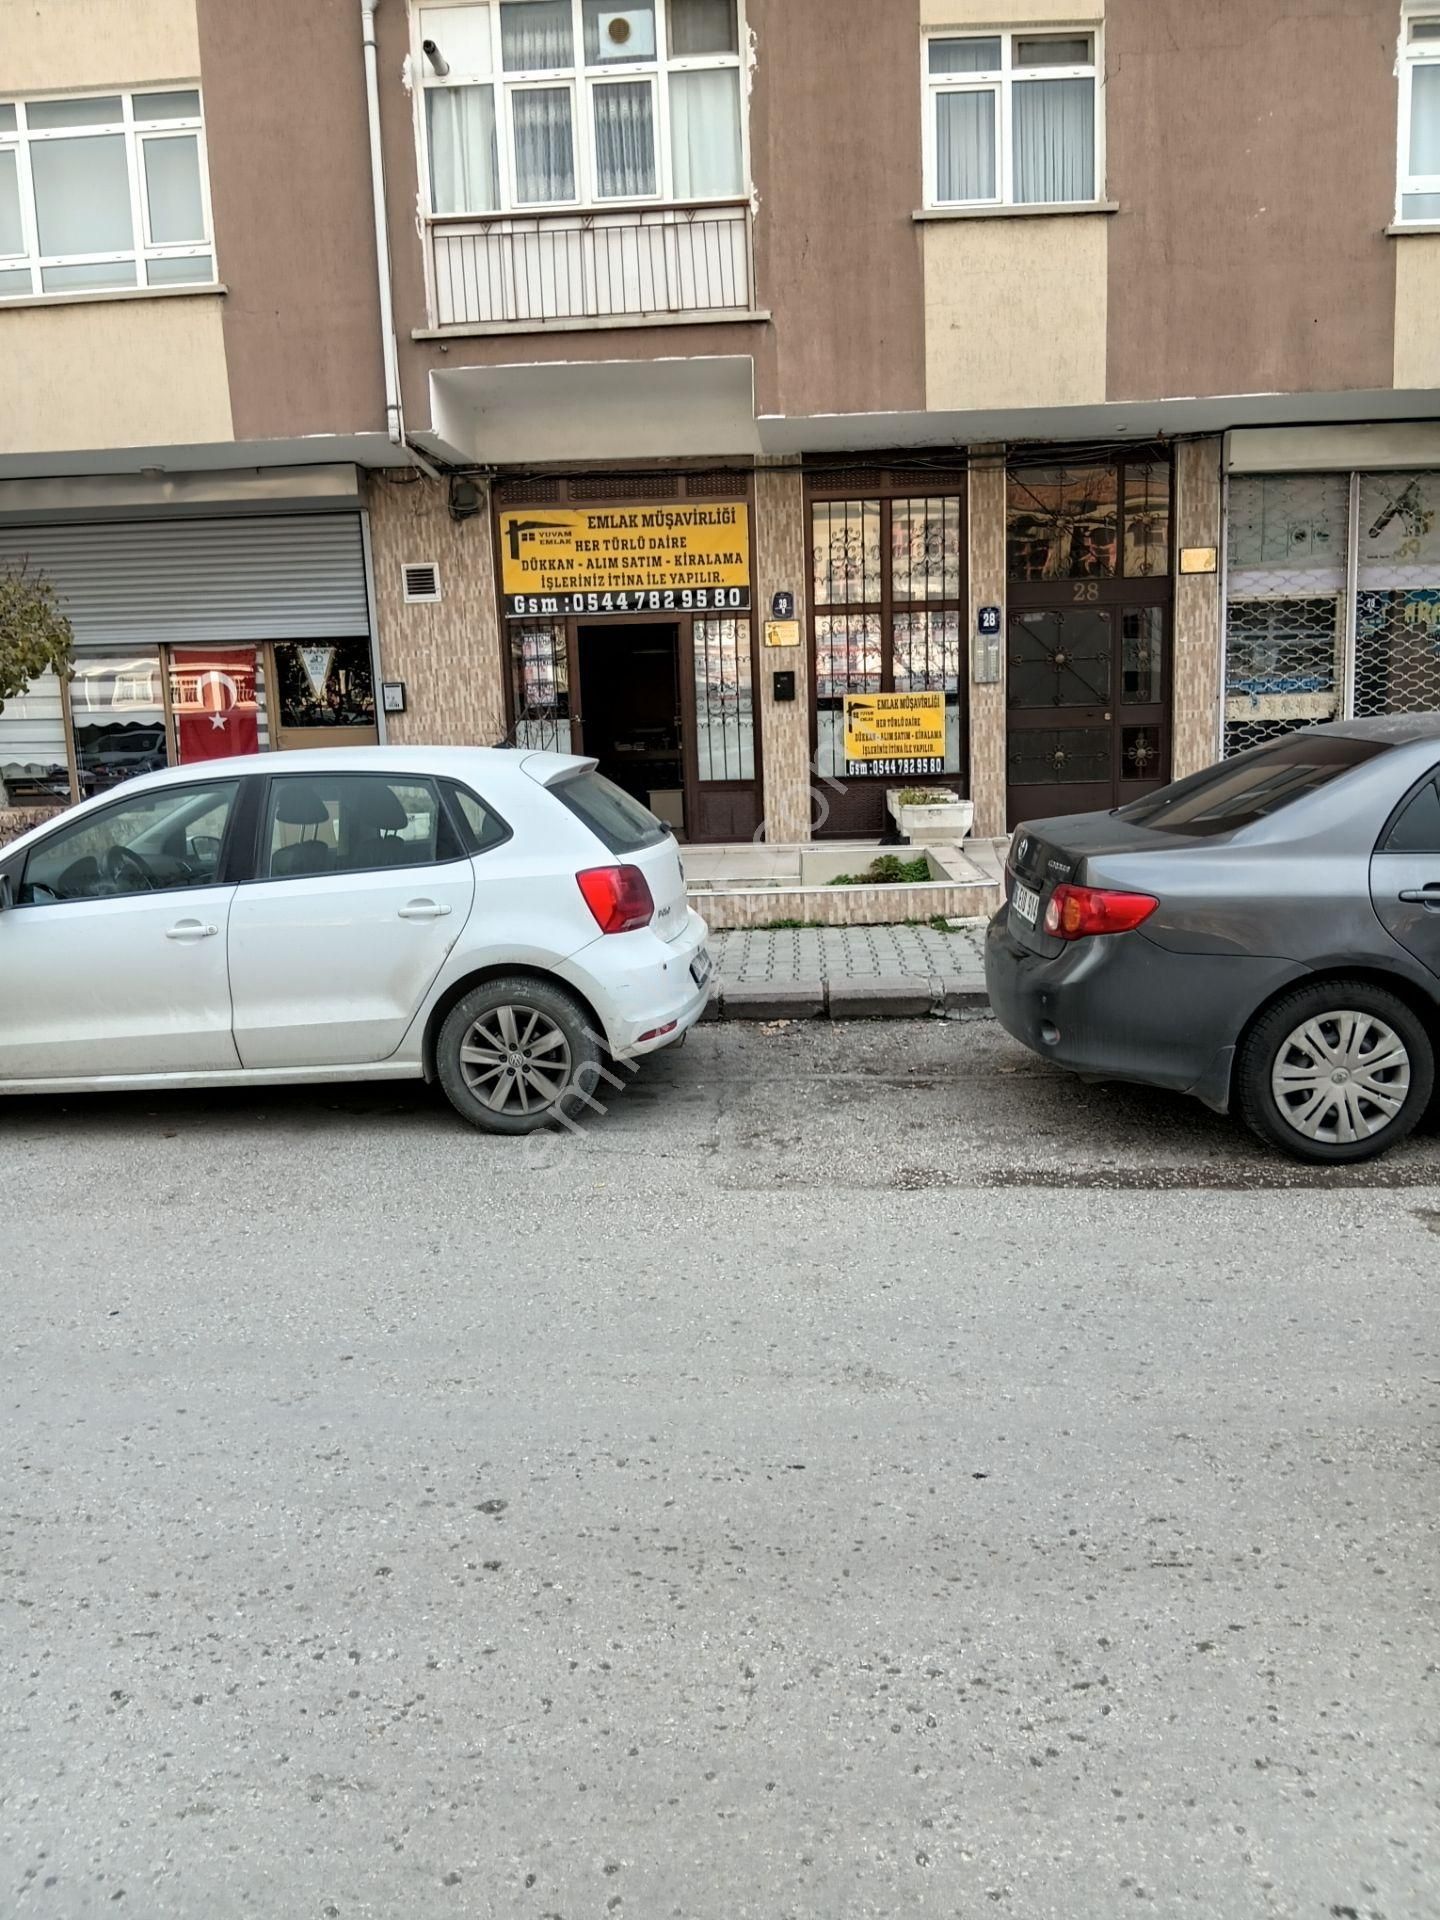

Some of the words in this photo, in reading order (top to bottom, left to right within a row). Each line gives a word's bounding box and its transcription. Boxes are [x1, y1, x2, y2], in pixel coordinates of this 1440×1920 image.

[588, 514, 638, 529] EMLAK
[642, 507, 736, 530] MÜŞAVİRLİĞİ
[575, 540, 600, 552] HER
[603, 535, 646, 551] TÜRLÜ
[649, 534, 687, 550] DAİRE
[521, 557, 574, 571] DÜKKAN
[586, 556, 619, 569] ALIM
[622, 556, 662, 569] SATIM
[674, 552, 743, 567] KİRALAMA
[541, 573, 605, 590] İŞLERİNİZ
[608, 572, 645, 587] İTİNA
[647, 571, 667, 585] İLE
[669, 571, 725, 585] YAPILIR.
[1073, 583, 1099, 601] 28
[514, 595, 558, 614] Gsm
[635, 591, 675, 610] 782
[983, 612, 996, 627] 28
[877, 698, 899, 710] EMLAK
[900, 694, 940, 711] MÜŞAVİRLİĞİ
[849, 760, 868, 775] Gsm
